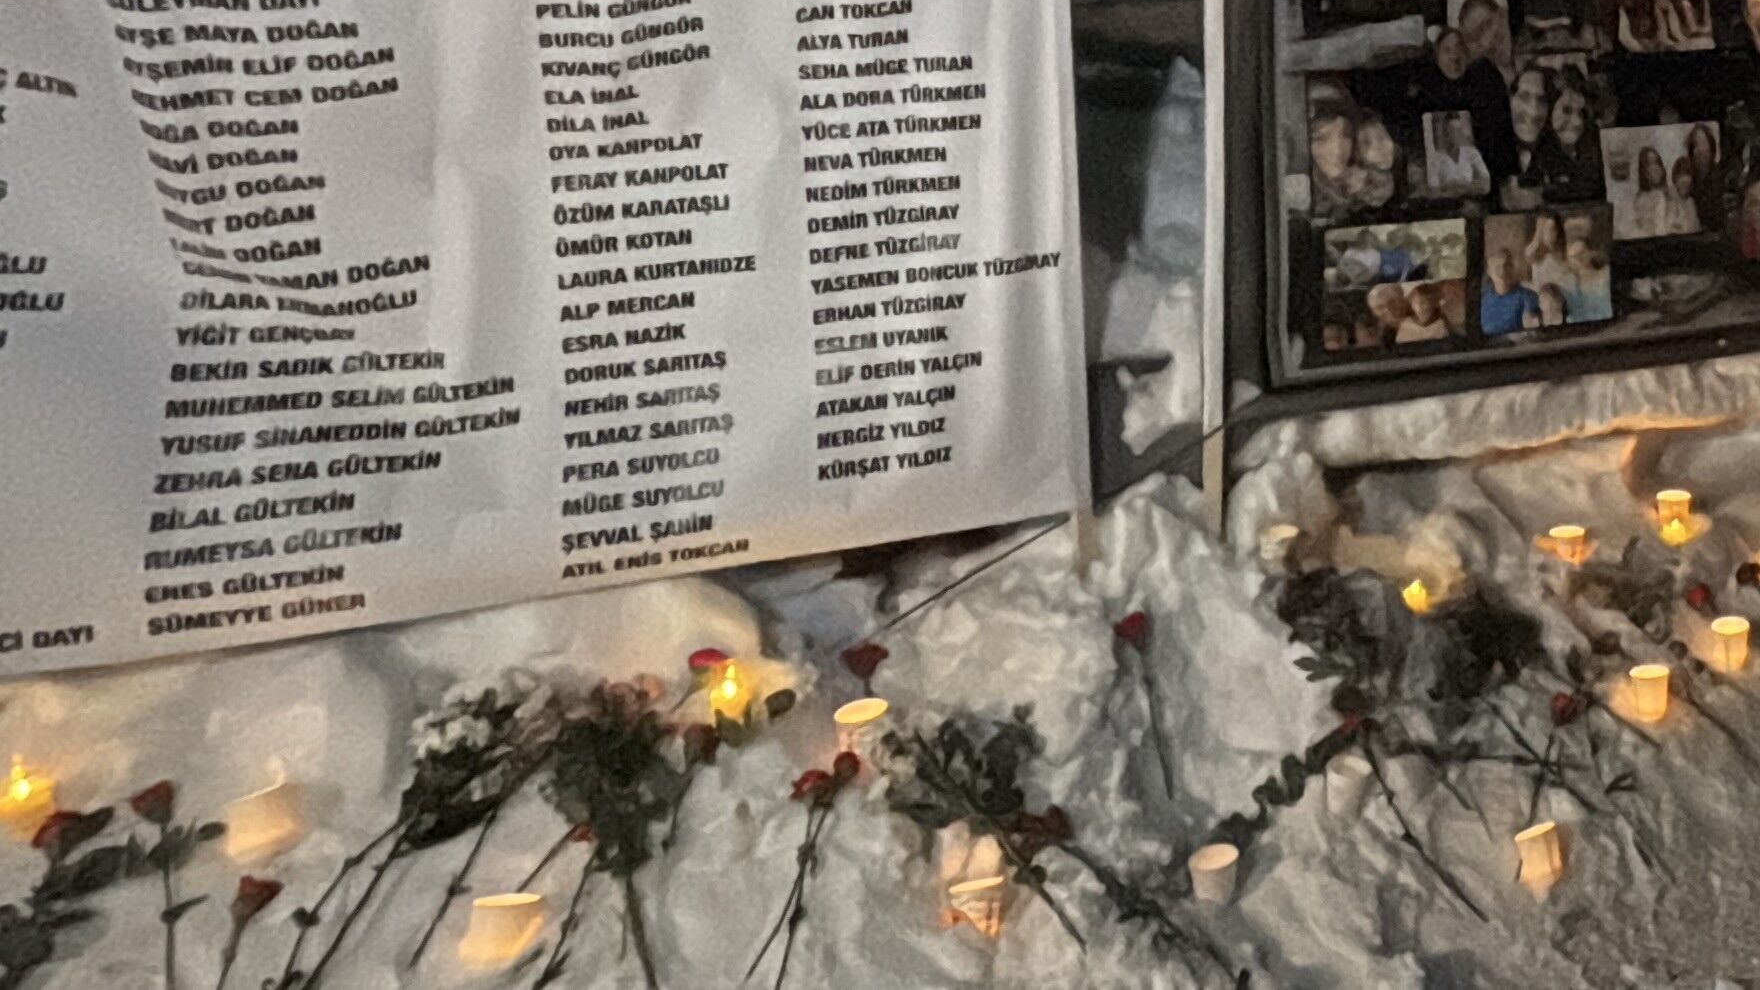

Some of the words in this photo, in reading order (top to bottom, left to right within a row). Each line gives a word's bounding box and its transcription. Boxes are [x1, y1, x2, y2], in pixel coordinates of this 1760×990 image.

[795, 3, 835, 23] CAN
[184, 24, 259, 44] MAYA
[266, 19, 360, 44] DOĞAN
[538, 32, 614, 49] BURCU
[796, 32, 844, 52] ALYA
[847, 28, 909, 50] TURAN
[306, 46, 395, 72] DOĞAN
[912, 54, 974, 74] TURAN
[311, 76, 399, 103] DOĞAN
[799, 93, 838, 111] ALA
[842, 89, 895, 108] DORA
[900, 82, 987, 105] TÜRKMEN
[207, 118, 299, 138] DOĞAN
[801, 120, 852, 141] YÜCE
[856, 120, 891, 138] ATA
[206, 148, 299, 171] DOĞAN
[548, 144, 591, 161] OYA
[597, 132, 703, 158] KANPOLAT
[804, 153, 854, 172] NEVA
[857, 145, 948, 167] TÜRKMEN
[235, 174, 327, 199] DOĞAN
[551, 171, 618, 194] FERAY
[625, 162, 729, 187] KANPOLAT
[872, 174, 961, 194] TÜRKMEN
[225, 203, 317, 233] DOĞAN
[233, 236, 322, 263] DOĞAN
[625, 228, 693, 251] KOTAN
[347, 254, 431, 284] DOĞAN
[559, 302, 601, 323] ALP
[606, 290, 695, 317] MERCAN
[882, 325, 949, 348] UYANIK
[564, 360, 637, 386] DORUK
[815, 393, 889, 419] ATAKAN
[161, 431, 247, 457] YUSUF
[414, 405, 521, 438] GÜLTEKİN
[563, 424, 643, 450] YILMAZ
[889, 417, 946, 438] YILDIZ
[327, 450, 442, 478] GÜLTEKİN
[895, 446, 953, 468] YILDIZ
[233, 491, 356, 523] GÜLTEKİN
[222, 563, 345, 594] GÜLTEKİN
[32, 625, 95, 649] DAYI
